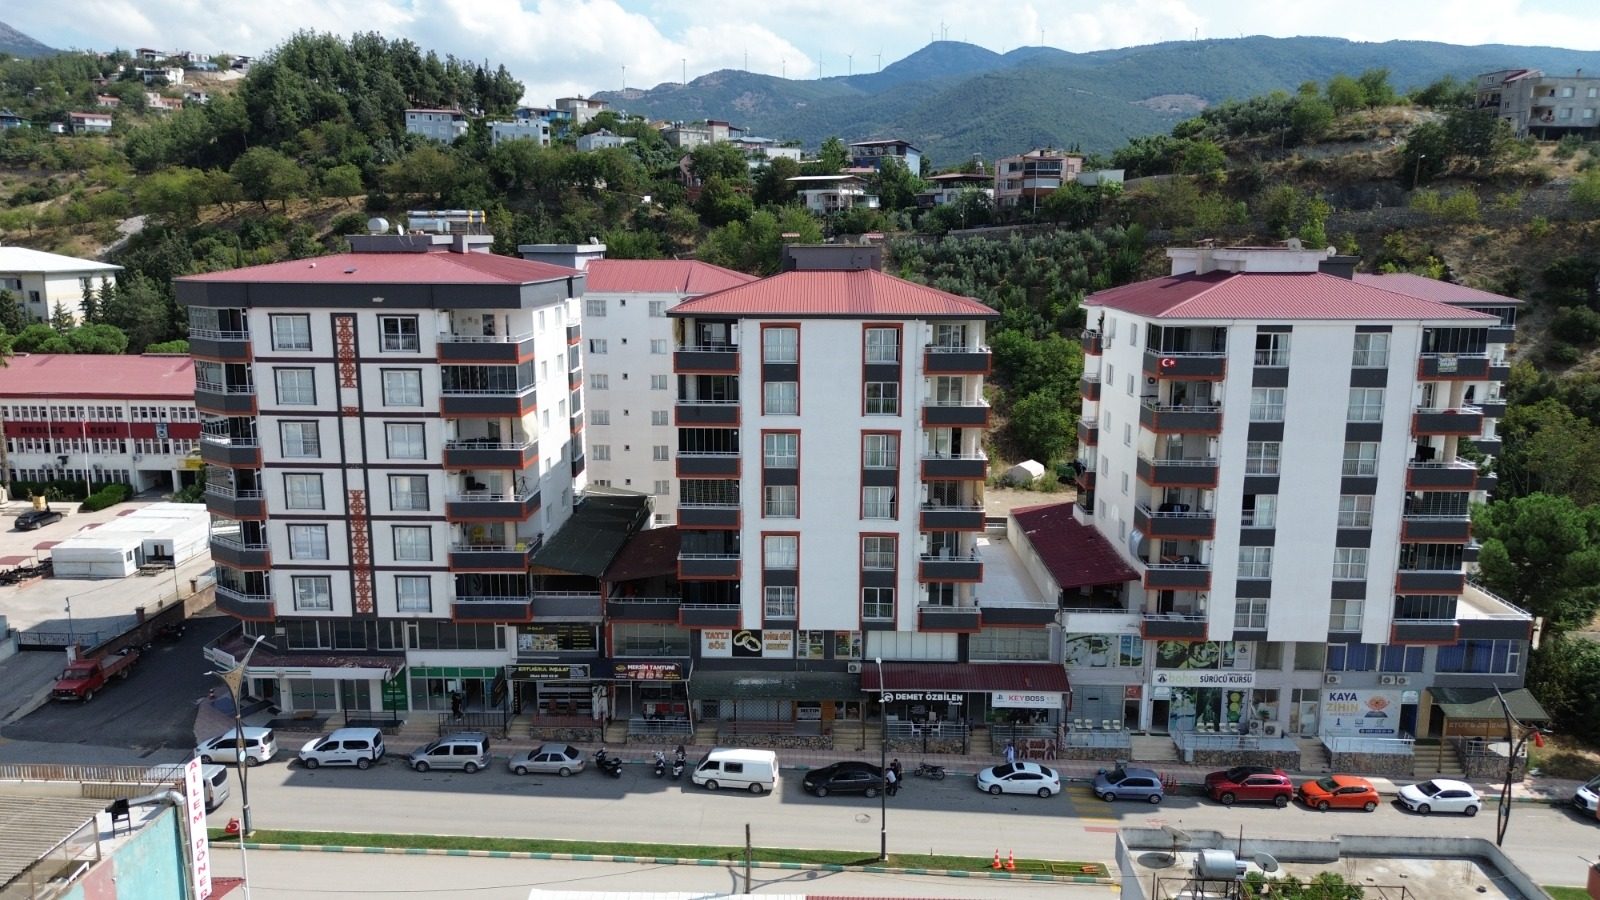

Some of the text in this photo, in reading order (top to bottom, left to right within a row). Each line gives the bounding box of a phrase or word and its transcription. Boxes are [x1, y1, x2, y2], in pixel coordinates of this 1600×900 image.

[704, 631, 729, 639] TATLI
[1200, 674, 1227, 683] SÜRÜCÜ
[925, 690, 963, 702] ÖZBİLEN
[1329, 692, 1358, 702] KAYA
[189, 761, 203, 825] AİLEM
